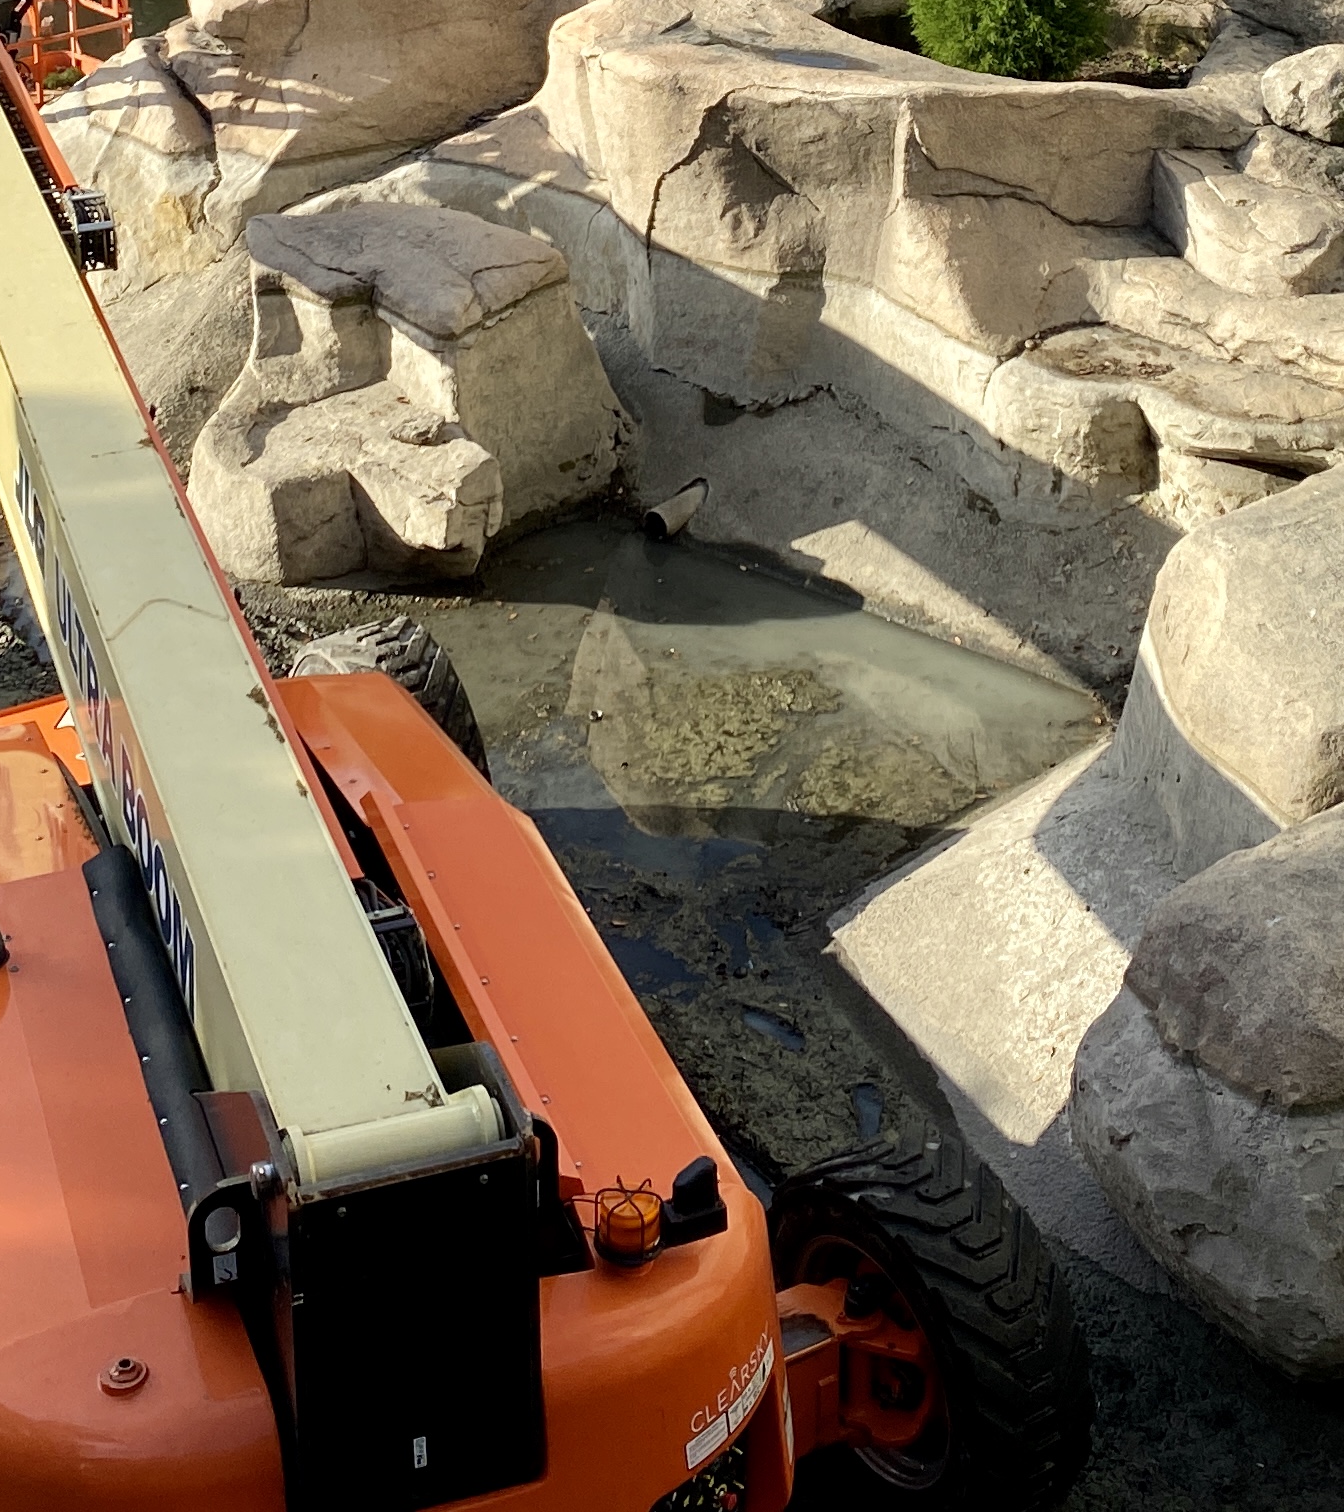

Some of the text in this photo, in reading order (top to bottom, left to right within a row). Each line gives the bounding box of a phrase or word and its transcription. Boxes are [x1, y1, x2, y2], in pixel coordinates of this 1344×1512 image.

[14, 445, 196, 1028] JLG ULTRA BOOM
